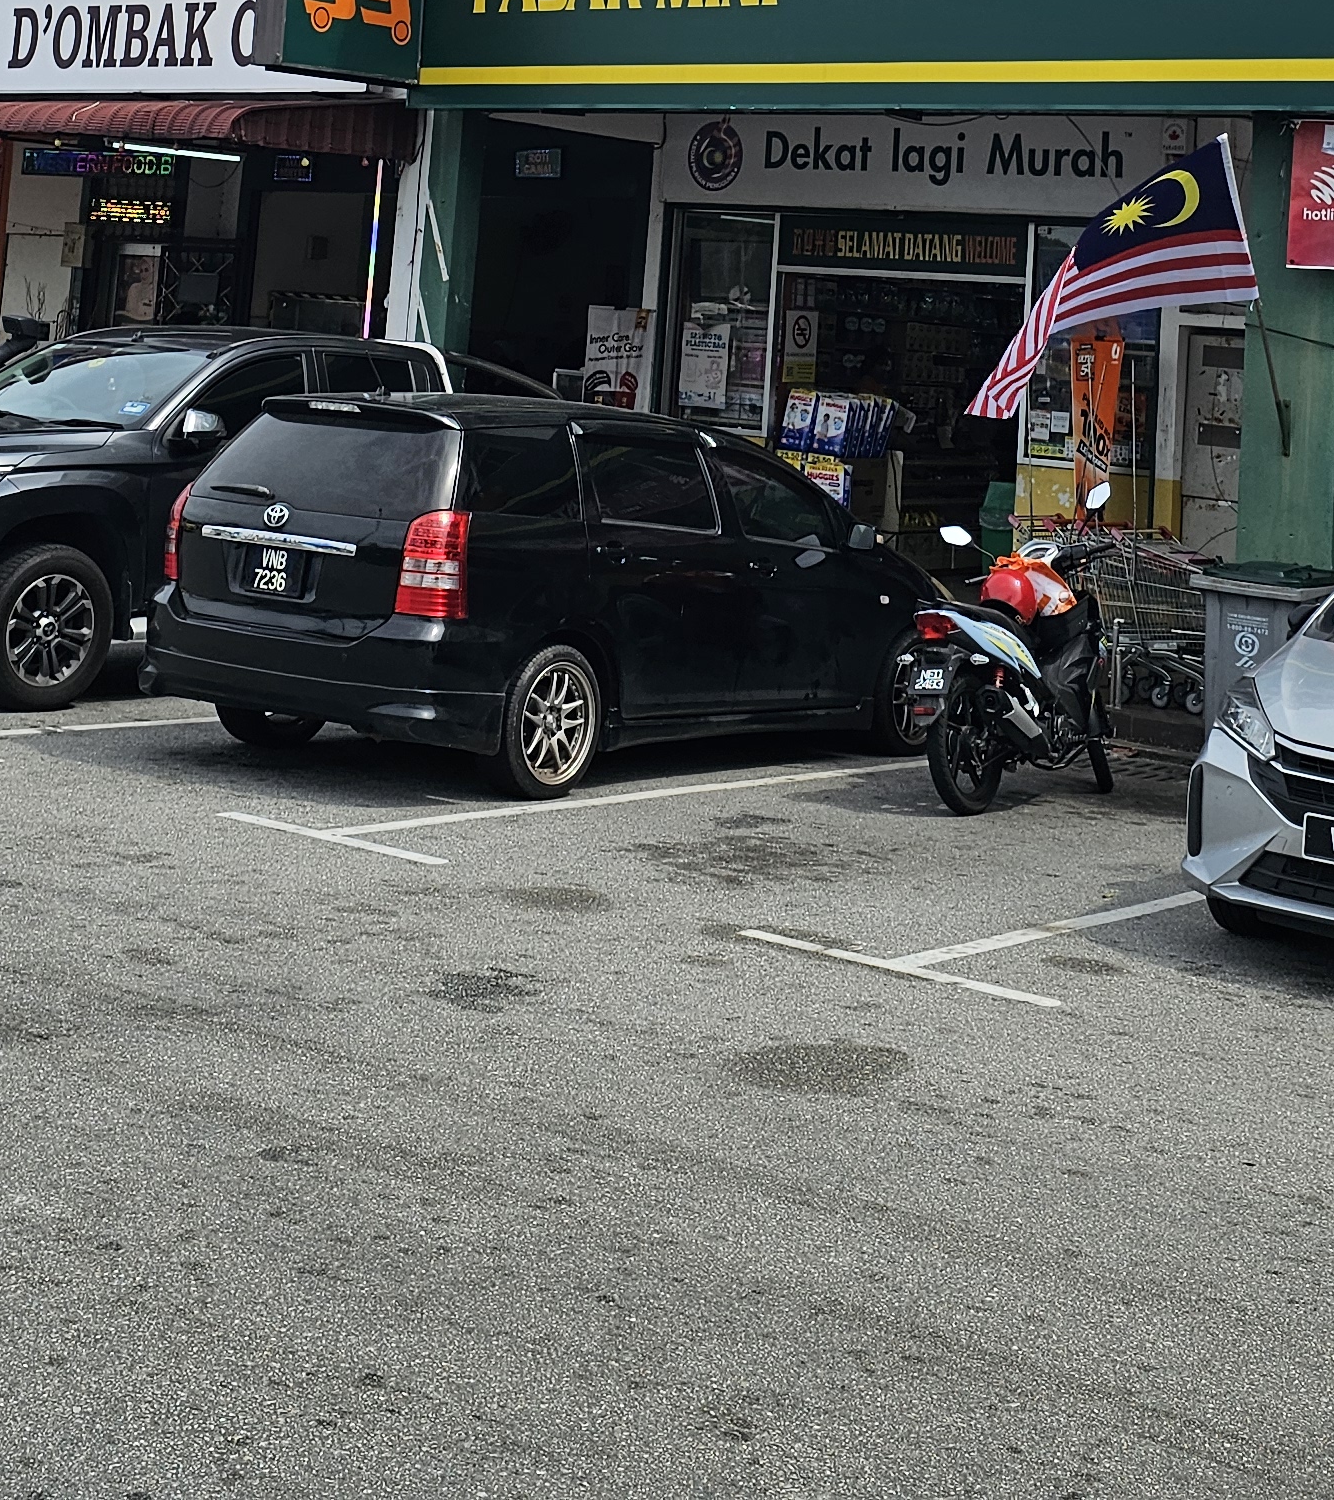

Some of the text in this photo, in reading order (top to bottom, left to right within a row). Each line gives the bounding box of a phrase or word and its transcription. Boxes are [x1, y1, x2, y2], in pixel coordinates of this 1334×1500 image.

[763, 126, 1124, 186] Dekat lagi Murah
[837, 230, 1018, 265] SELAMAT DATANG WELCOME
[590, 333, 611, 345] Inner
[685, 339, 712, 348] PLASTIC
[806, 471, 840, 482] HUGGIES
[261, 548, 288, 571] VNB
[254, 569, 286, 592] 7236
